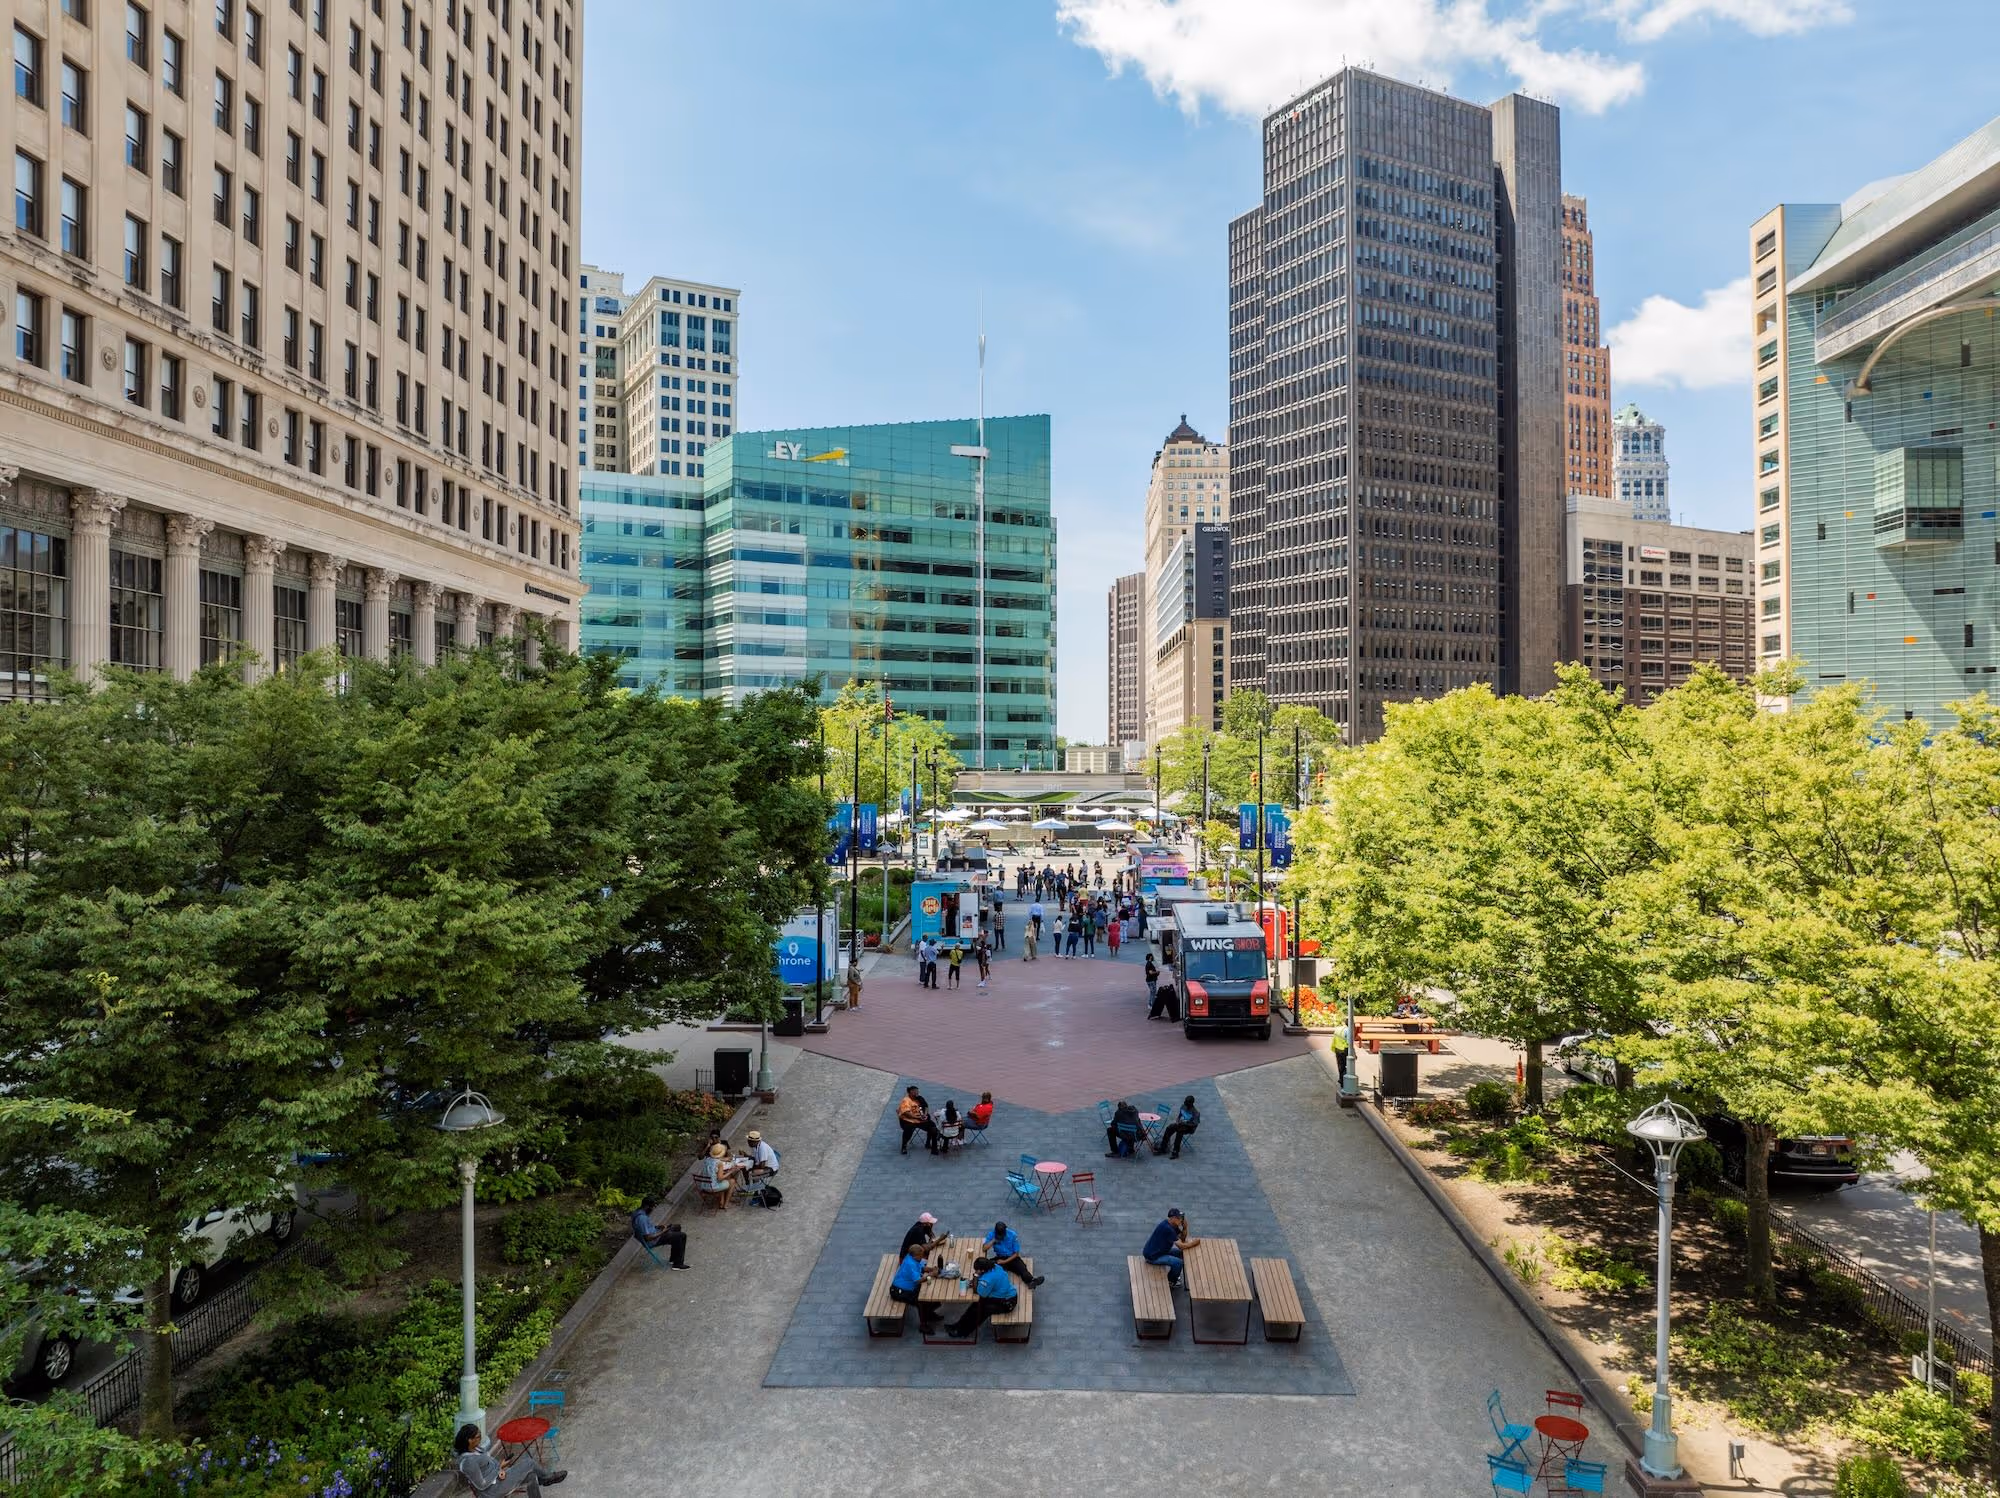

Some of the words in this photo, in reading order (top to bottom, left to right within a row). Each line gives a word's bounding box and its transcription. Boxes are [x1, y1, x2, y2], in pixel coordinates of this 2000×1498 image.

[775, 440, 801, 460] EY
[1191, 939, 1234, 951] WING
[1234, 938, 1260, 950] SNOB
[779, 955, 811, 966] hrone
